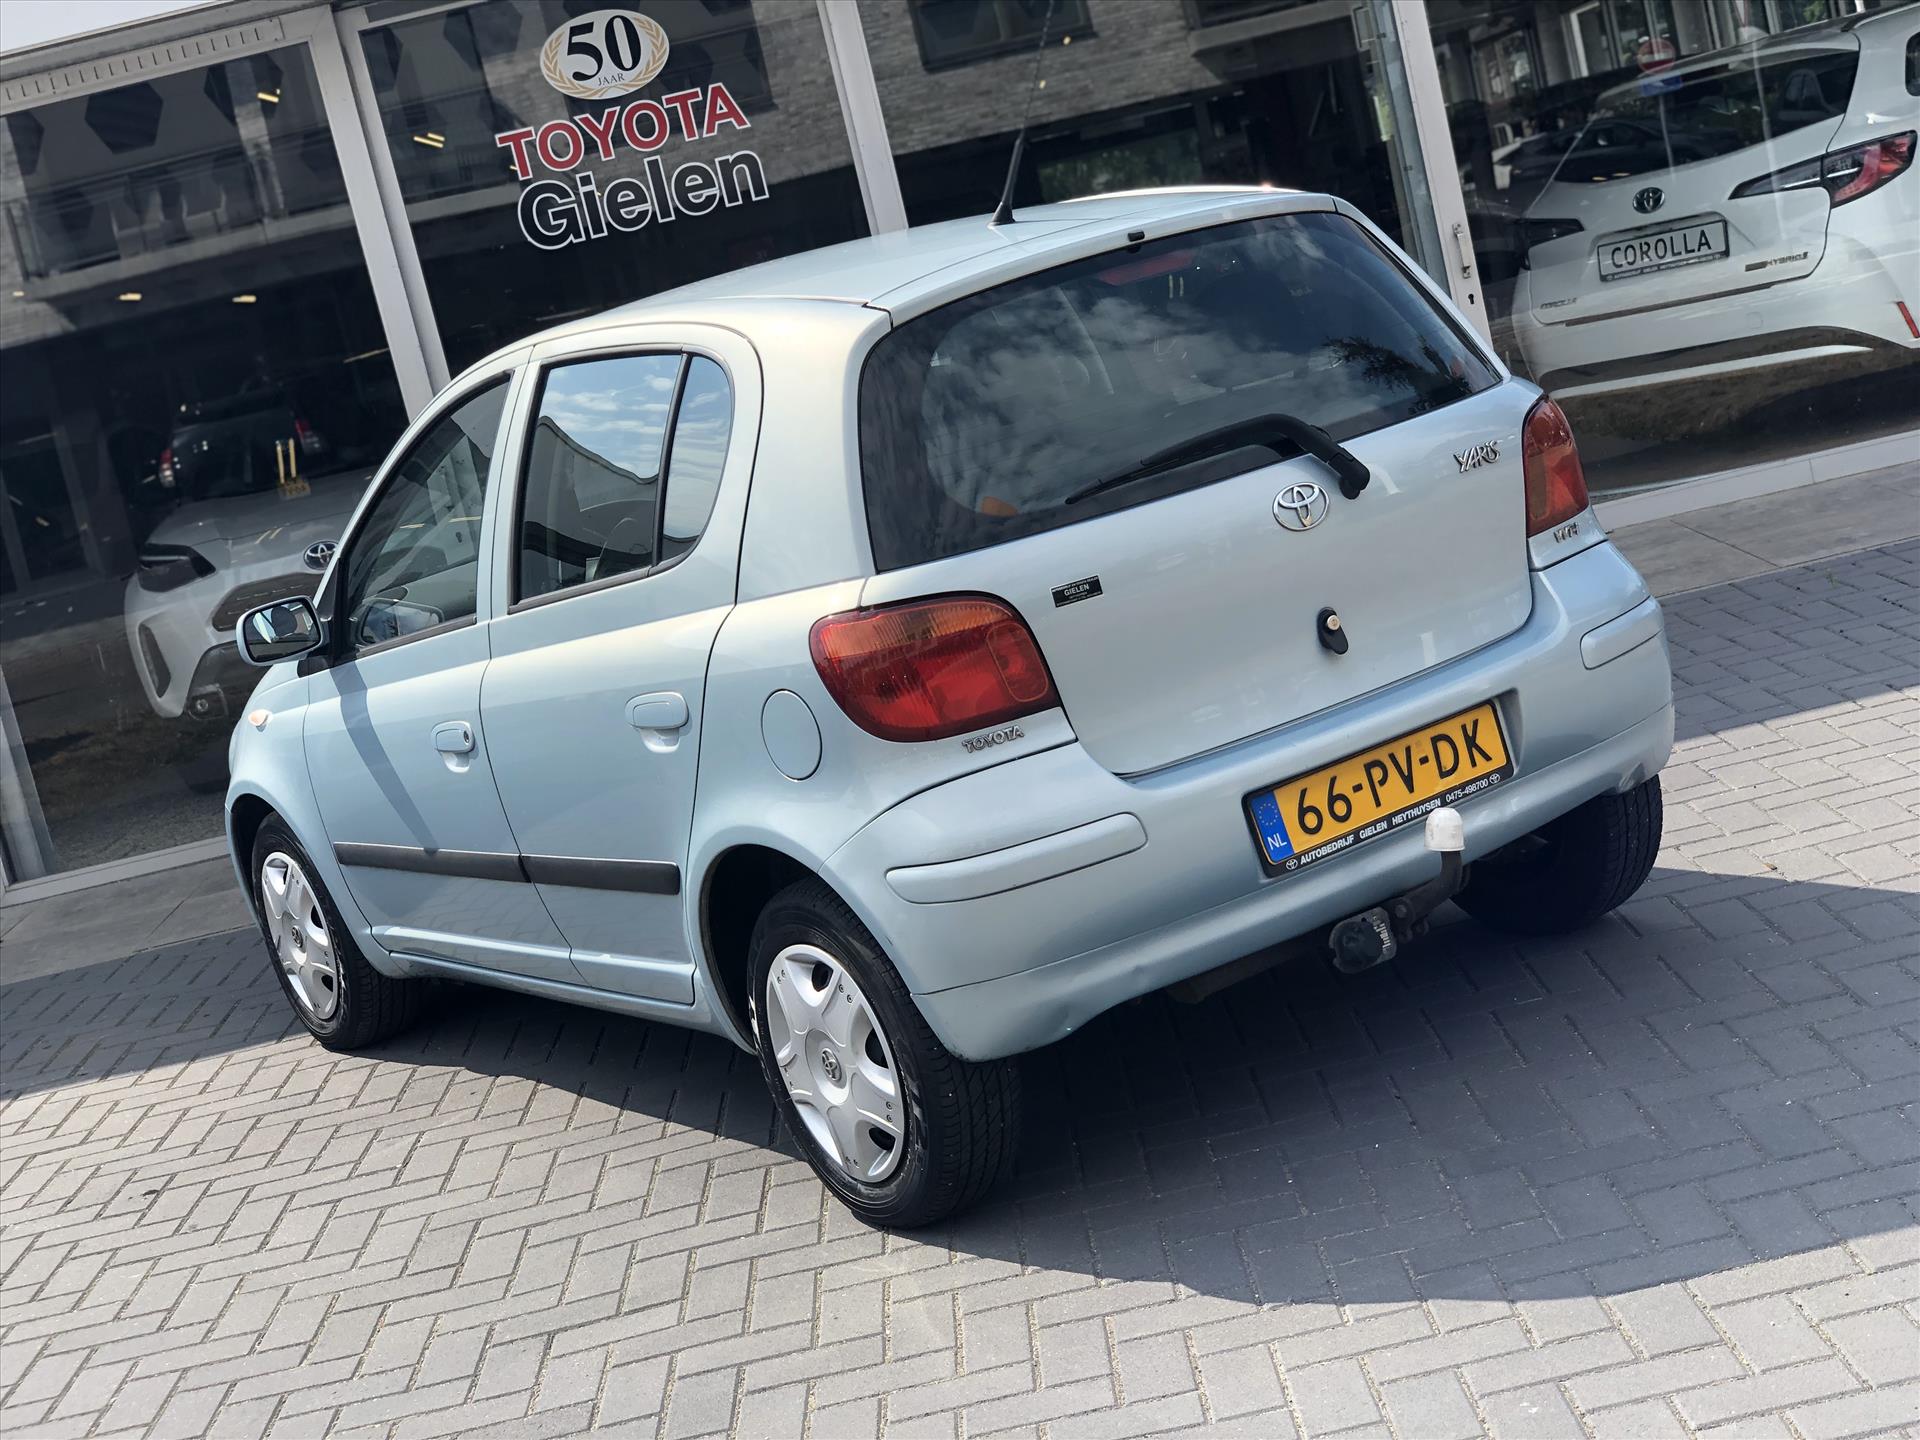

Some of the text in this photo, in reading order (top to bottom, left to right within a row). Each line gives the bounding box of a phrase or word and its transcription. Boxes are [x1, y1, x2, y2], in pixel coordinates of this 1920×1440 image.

[566, 14, 642, 82] 50
[597, 72, 625, 87] JAAR
[495, 82, 751, 180] TOYOTA
[518, 150, 769, 250] Gielen
[1611, 229, 1712, 269] COROLLA
[1064, 583, 1089, 597] GIELEN
[962, 725, 1025, 753] TOYOTA
[1297, 718, 1492, 835] 66-PV-DK
[1267, 833, 1287, 850] NL
[1300, 778, 1489, 866] AUTOBEDRIJF GIELEN HEYTHUYSEN 0475-498700
